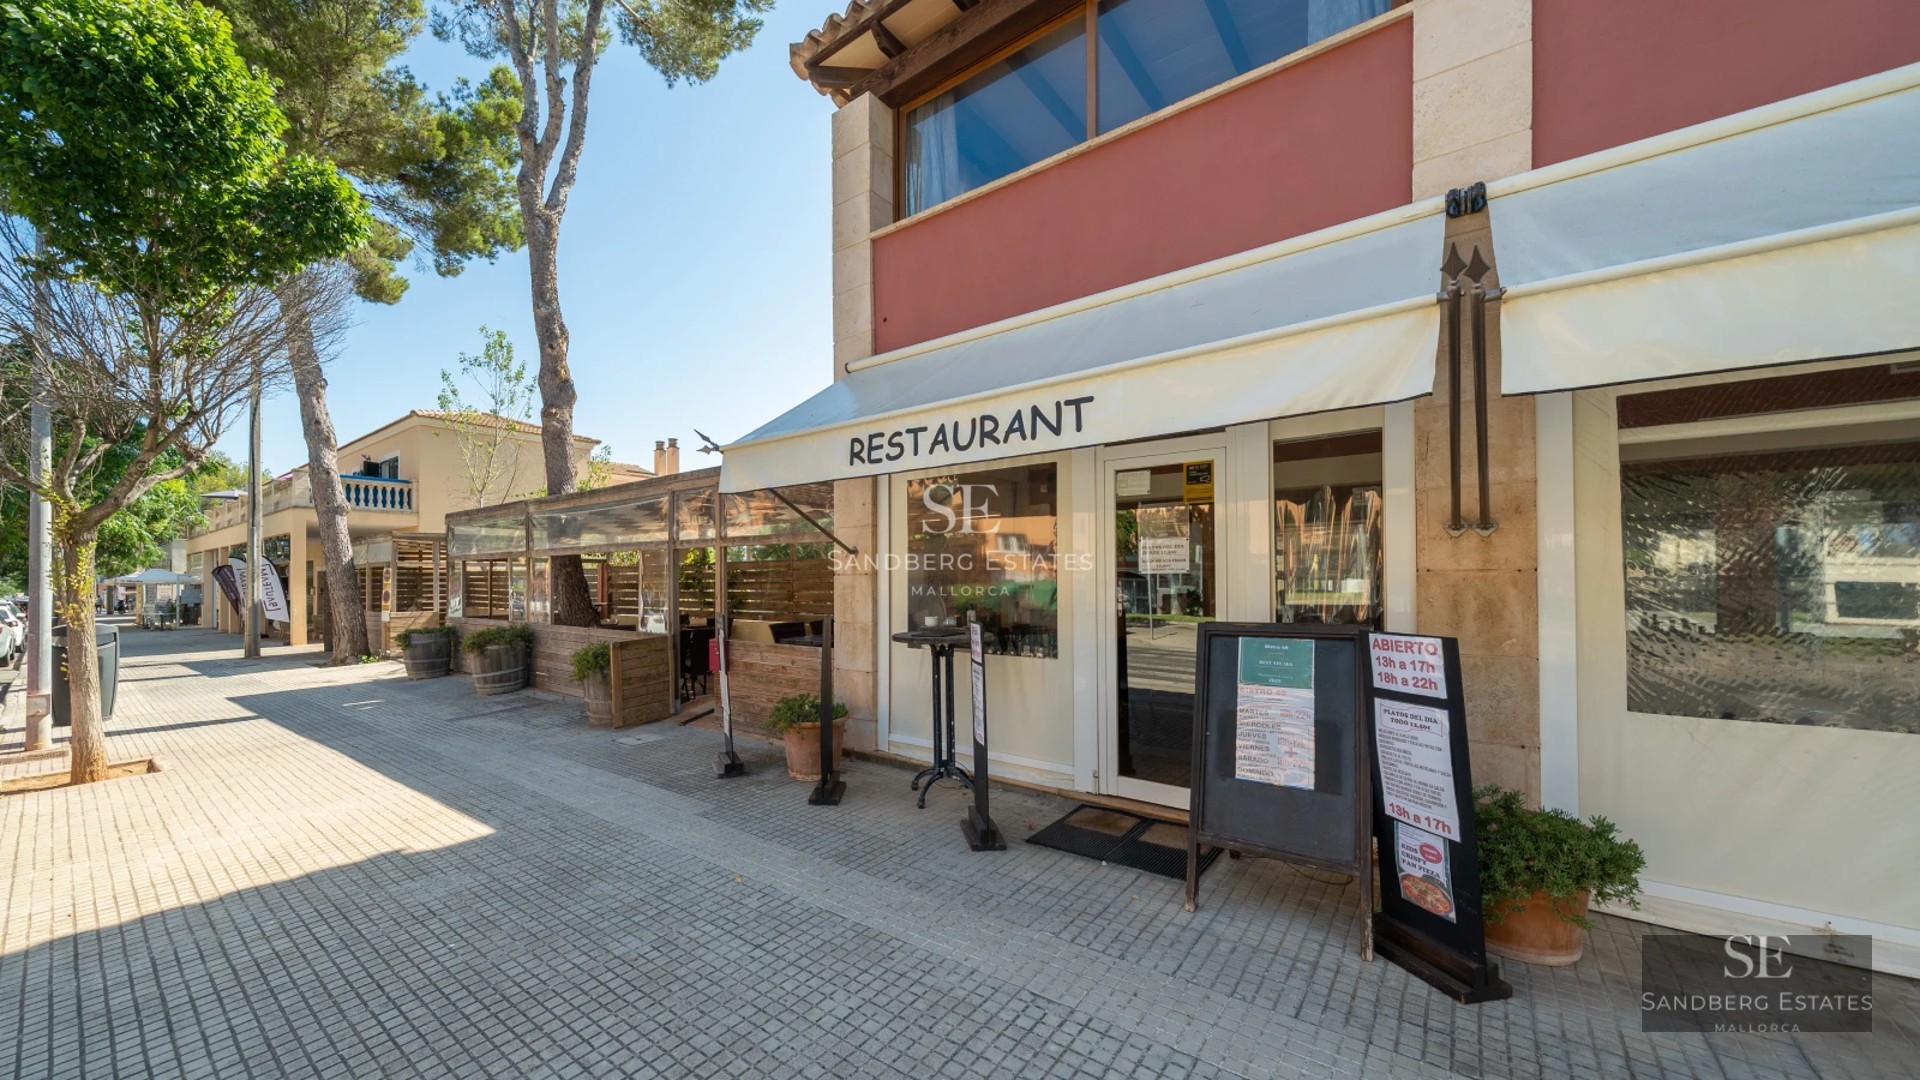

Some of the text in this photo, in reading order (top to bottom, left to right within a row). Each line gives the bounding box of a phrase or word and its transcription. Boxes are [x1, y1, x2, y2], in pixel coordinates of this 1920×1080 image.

[849, 395, 1095, 466] RESTAURANT
[1372, 638, 1438, 656] ABIERTO
[1376, 655, 1435, 673] 13h a 17h
[1378, 672, 1438, 690] 18h a 22h
[1383, 709, 1439, 725] PLATOS DEL DIA
[1391, 717, 1409, 726] TODO
[1389, 802, 1410, 820] 13h
[1413, 813, 1421, 824] a
[1424, 815, 1452, 835] 17h
[1401, 843, 1418, 854] KIDS
